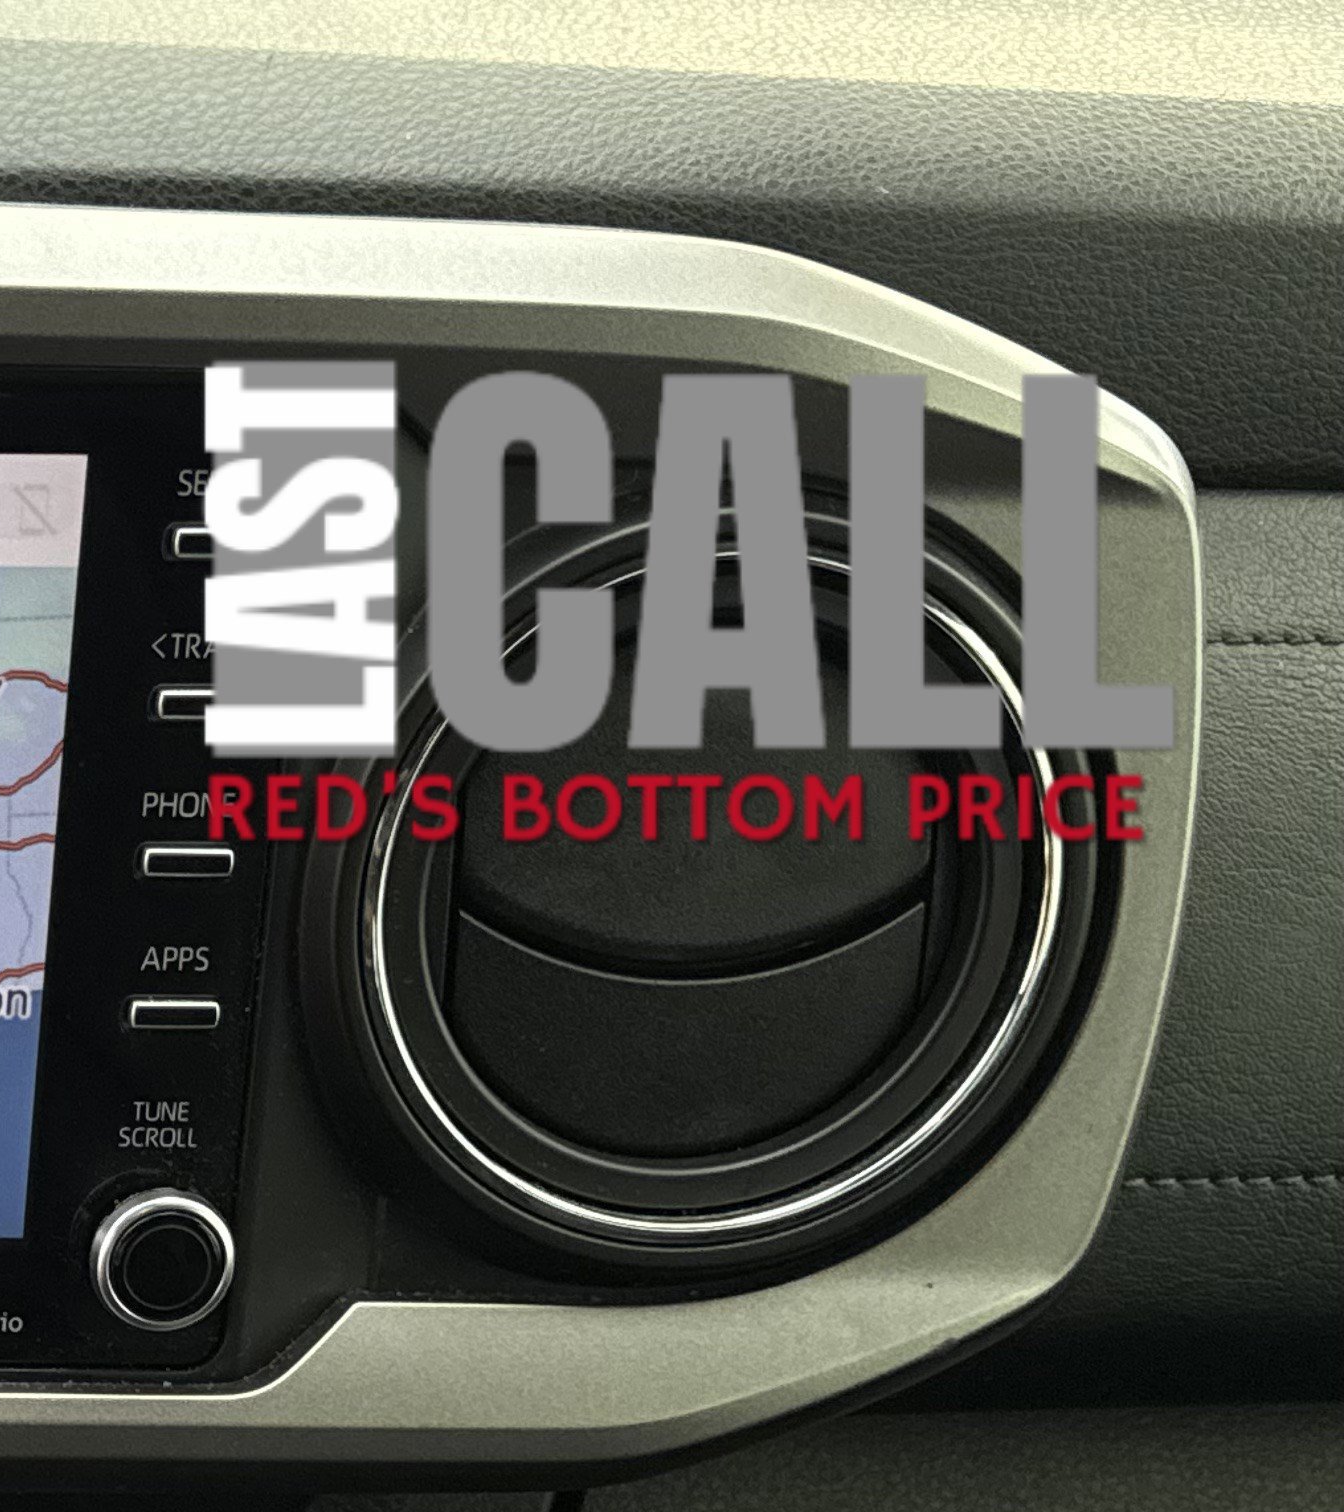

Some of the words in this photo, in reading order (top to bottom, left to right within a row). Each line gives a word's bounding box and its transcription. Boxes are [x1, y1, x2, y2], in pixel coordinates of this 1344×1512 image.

[140, 946, 209, 972] APPS
[133, 1101, 189, 1122] TUNE
[118, 1125, 197, 1148] SCROLL
